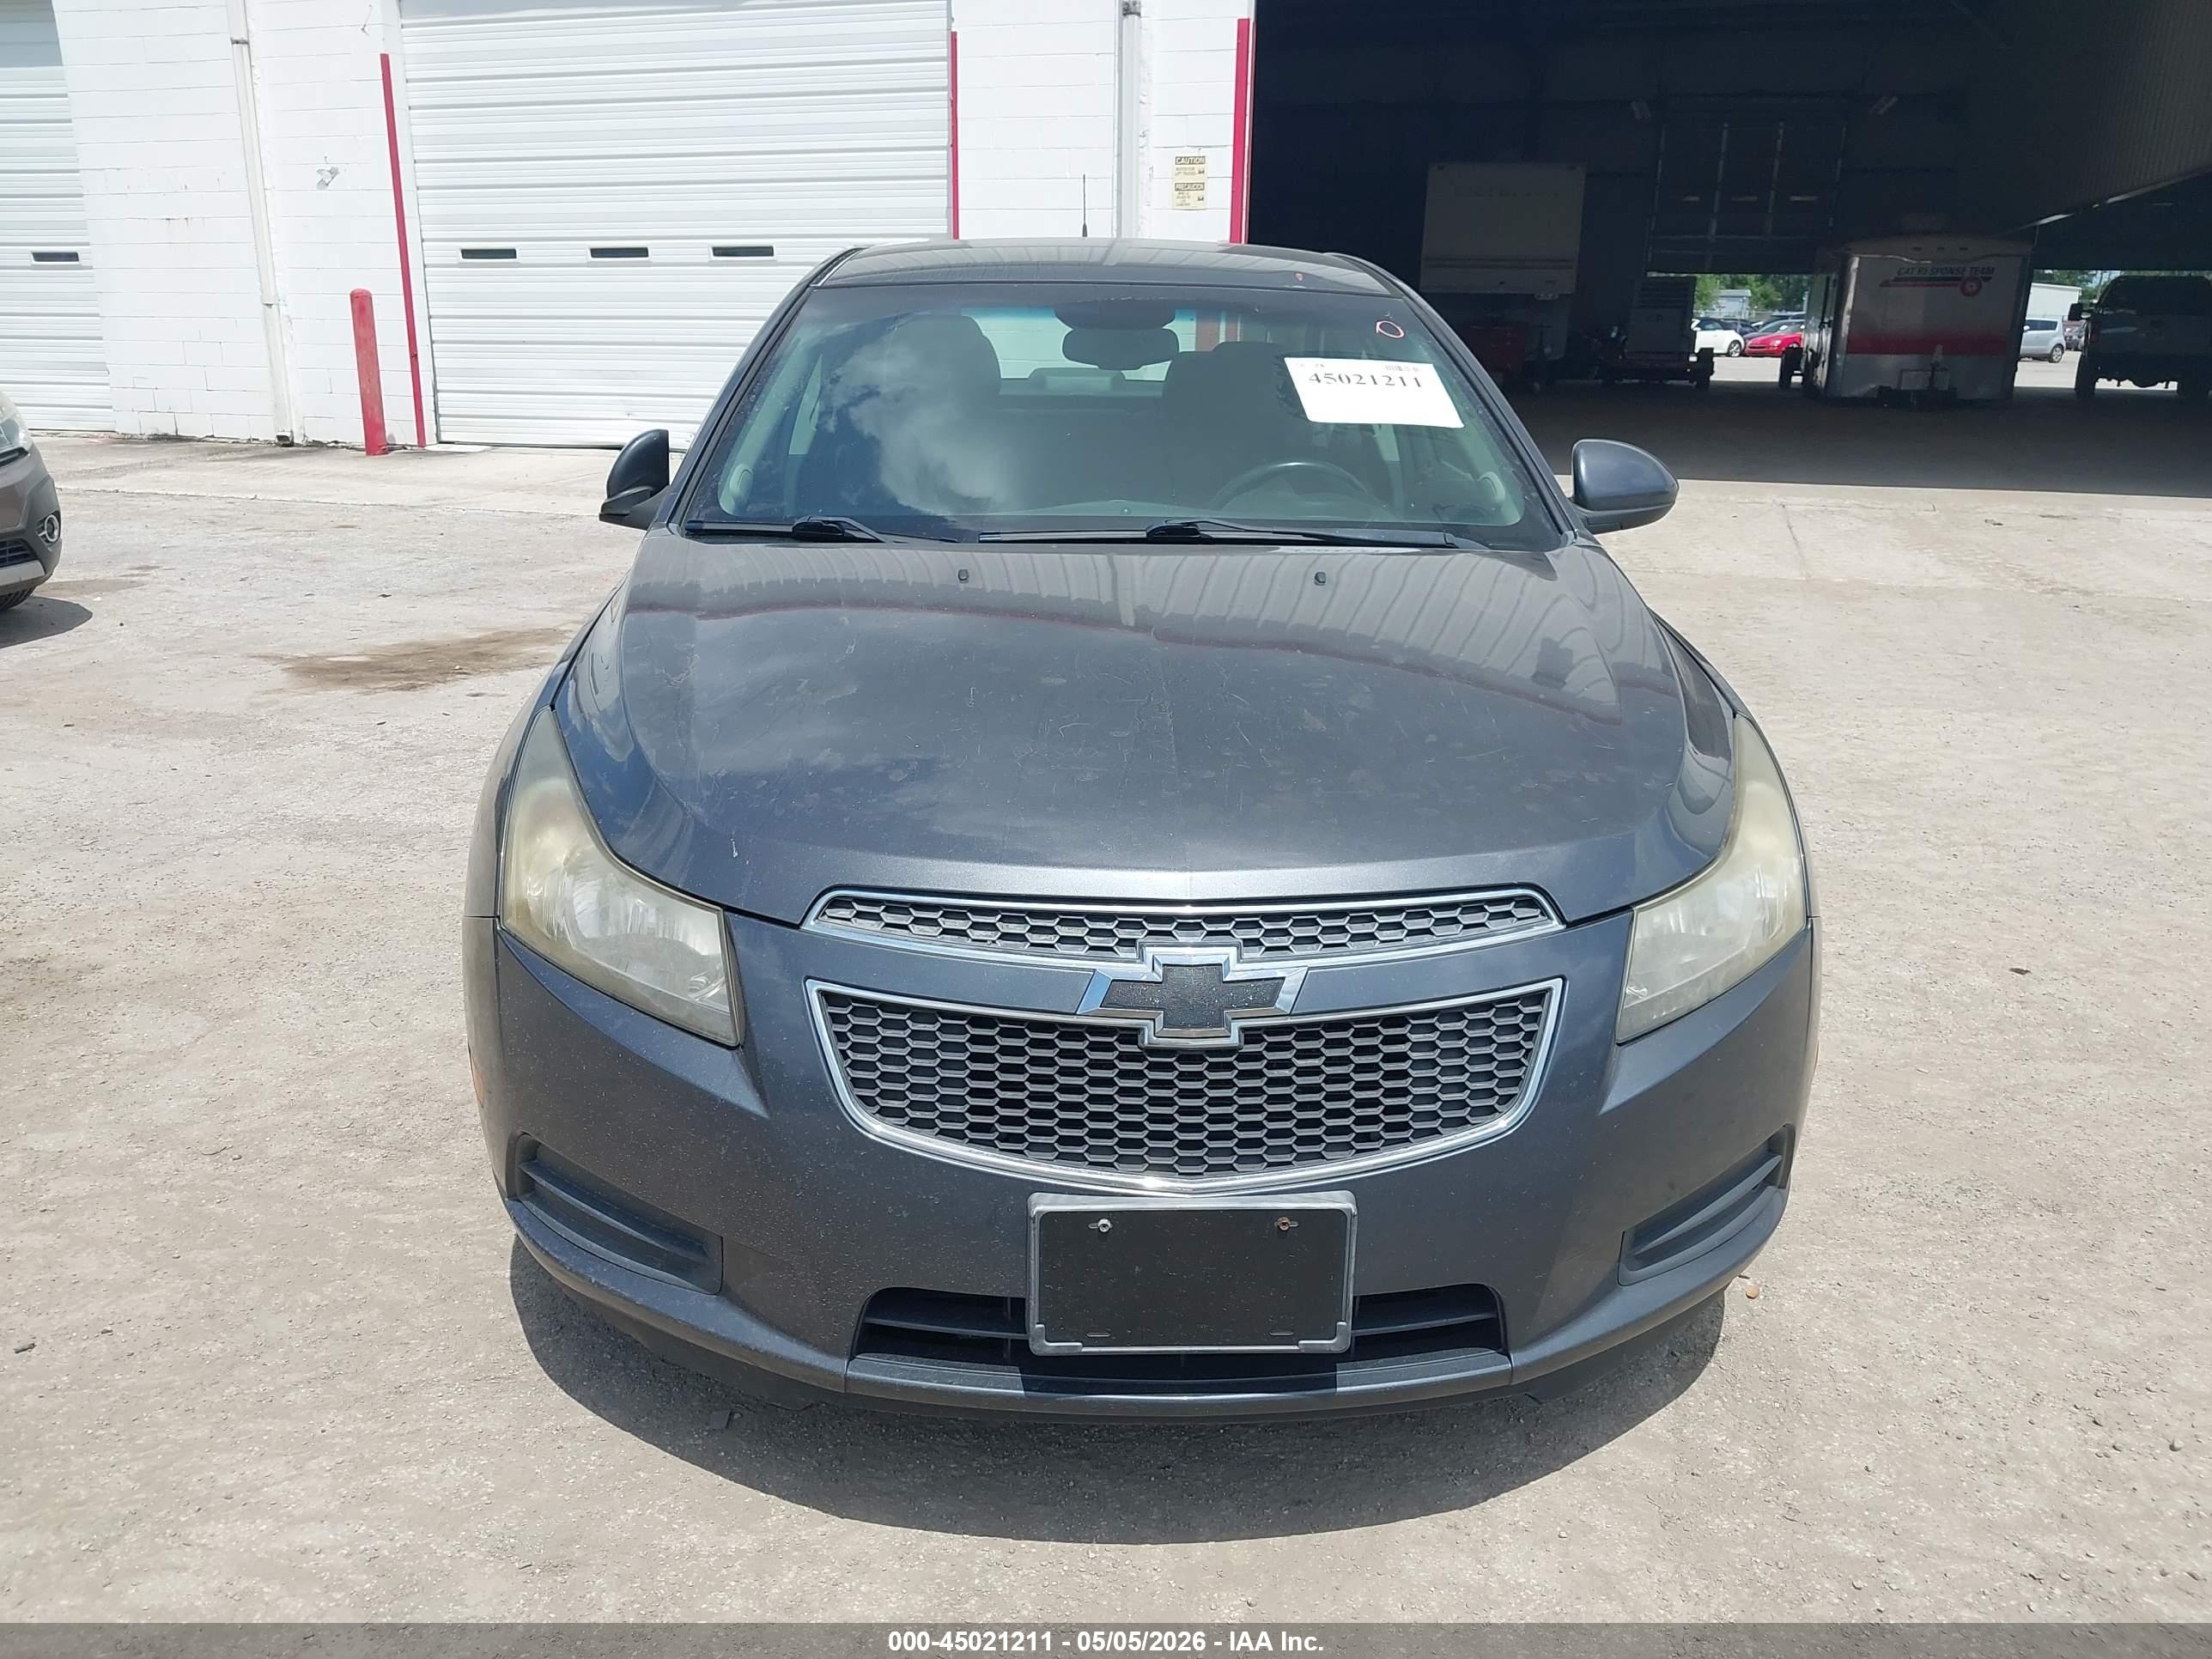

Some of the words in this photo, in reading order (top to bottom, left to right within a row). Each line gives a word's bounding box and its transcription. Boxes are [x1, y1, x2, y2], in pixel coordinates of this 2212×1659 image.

[1897, 267, 1915, 276] CAT
[1970, 266, 1996, 275] TEAM
[1309, 372, 1422, 388] 45021211
